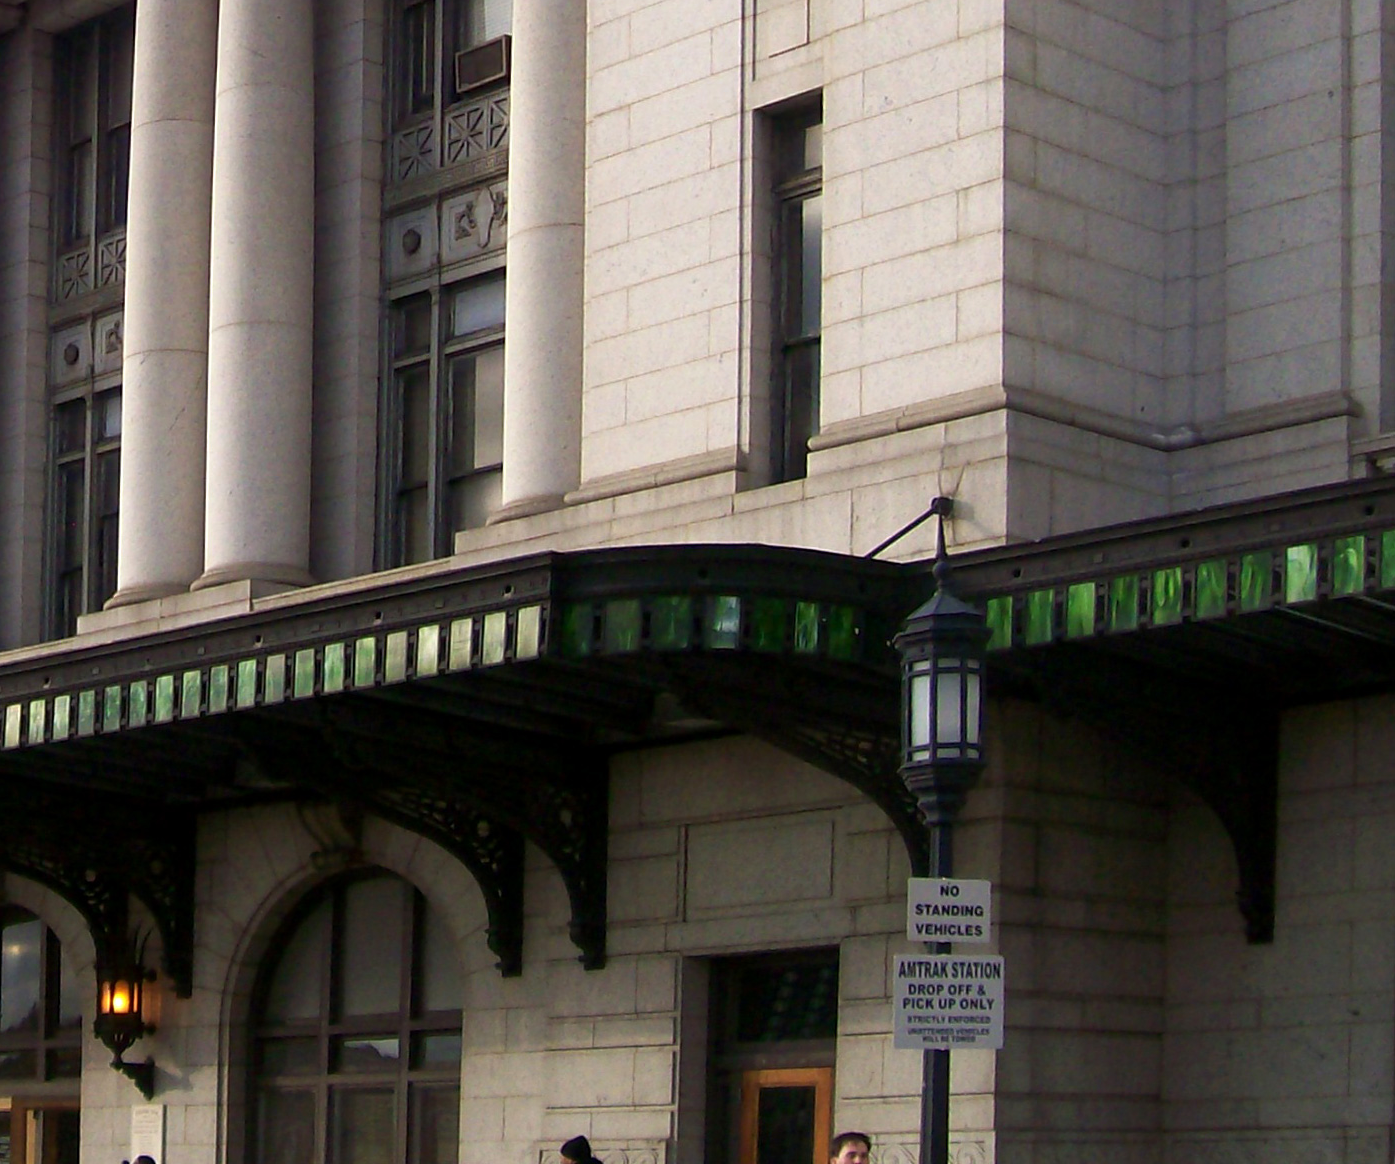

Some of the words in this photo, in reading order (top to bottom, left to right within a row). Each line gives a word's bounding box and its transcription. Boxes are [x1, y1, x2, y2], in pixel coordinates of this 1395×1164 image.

[939, 885, 960, 897] NO
[915, 903, 984, 917] STANDING
[915, 923, 983, 937] VEHICLES
[898, 961, 948, 979] AMTRAK
[951, 961, 1002, 980] STATION
[908, 984, 945, 996] DROP
[947, 984, 973, 996] OFF
[977, 985, 987, 996] &
[903, 997, 935, 1010] PICK
[938, 997, 957, 1010] UP
[959, 998, 995, 1011] ONLY
[907, 1015, 946, 1024] STRICTLY
[947, 1015, 992, 1025] ENFORCED
